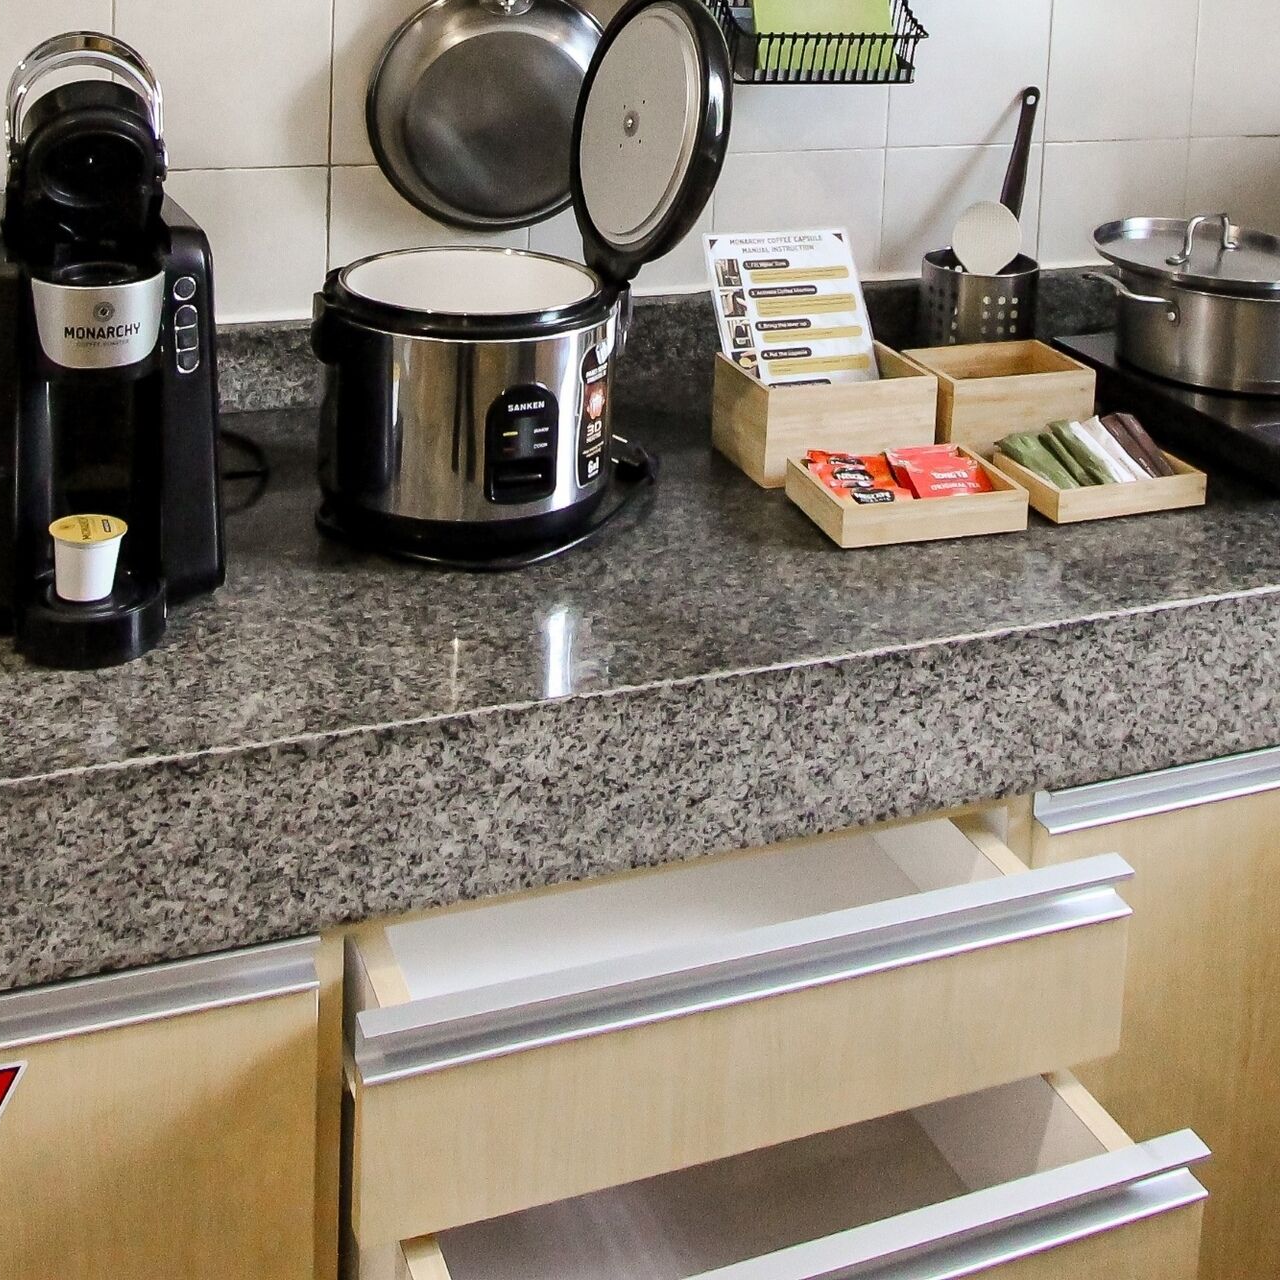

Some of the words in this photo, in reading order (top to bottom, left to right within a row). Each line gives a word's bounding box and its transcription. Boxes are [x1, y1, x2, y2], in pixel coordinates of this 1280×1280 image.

[729, 237, 766, 246] MONARCHY
[767, 236, 791, 244] COFFEE
[793, 234, 823, 243] CAPSULE
[771, 244, 815, 253] INSTRUCTION
[64, 322, 141, 340] MONARCHY
[507, 400, 545, 412] SANKEN
